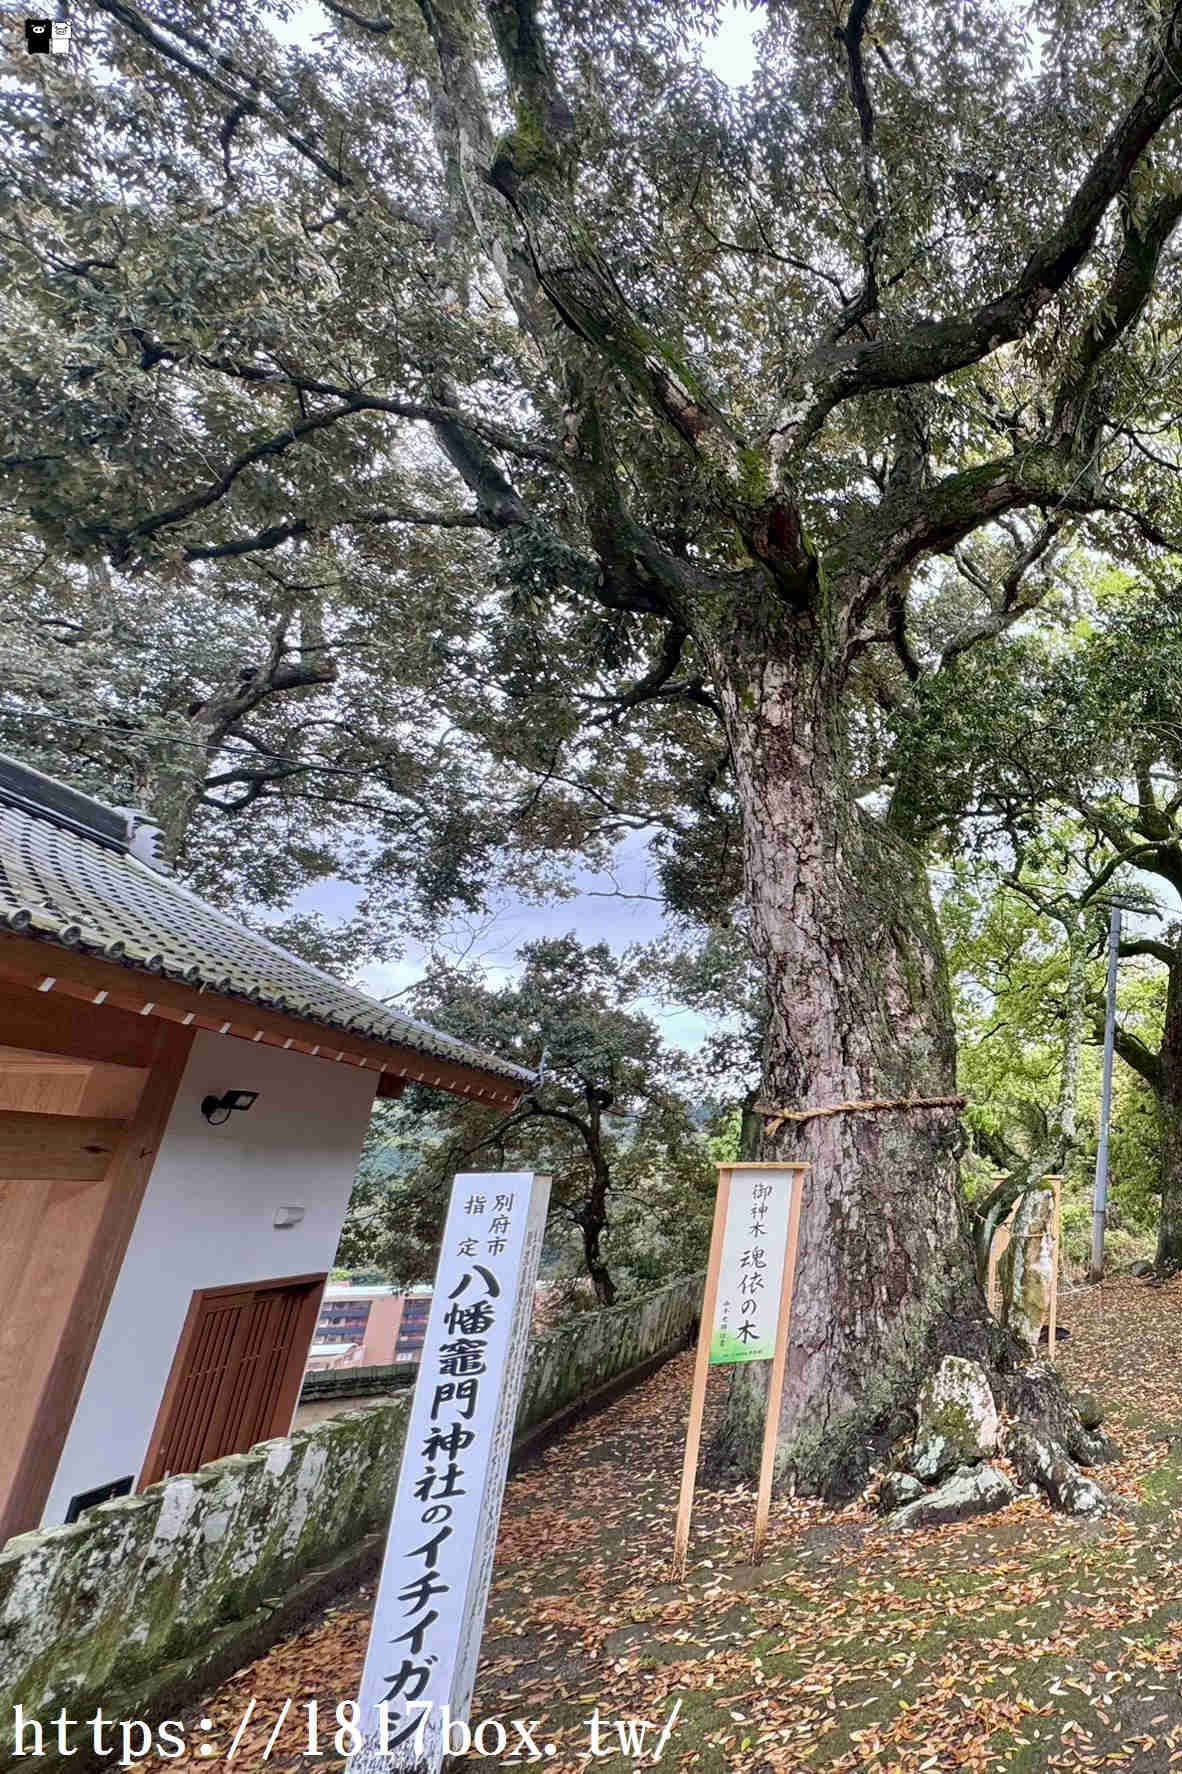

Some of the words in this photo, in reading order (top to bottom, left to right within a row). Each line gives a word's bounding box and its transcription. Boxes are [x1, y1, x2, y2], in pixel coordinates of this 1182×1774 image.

[455, 1194, 488, 1258] 指定
[488, 1192, 515, 1257] 別府市
[749, 1182, 773, 1238] 御神木
[736, 1245, 768, 1345] 魂依の木
